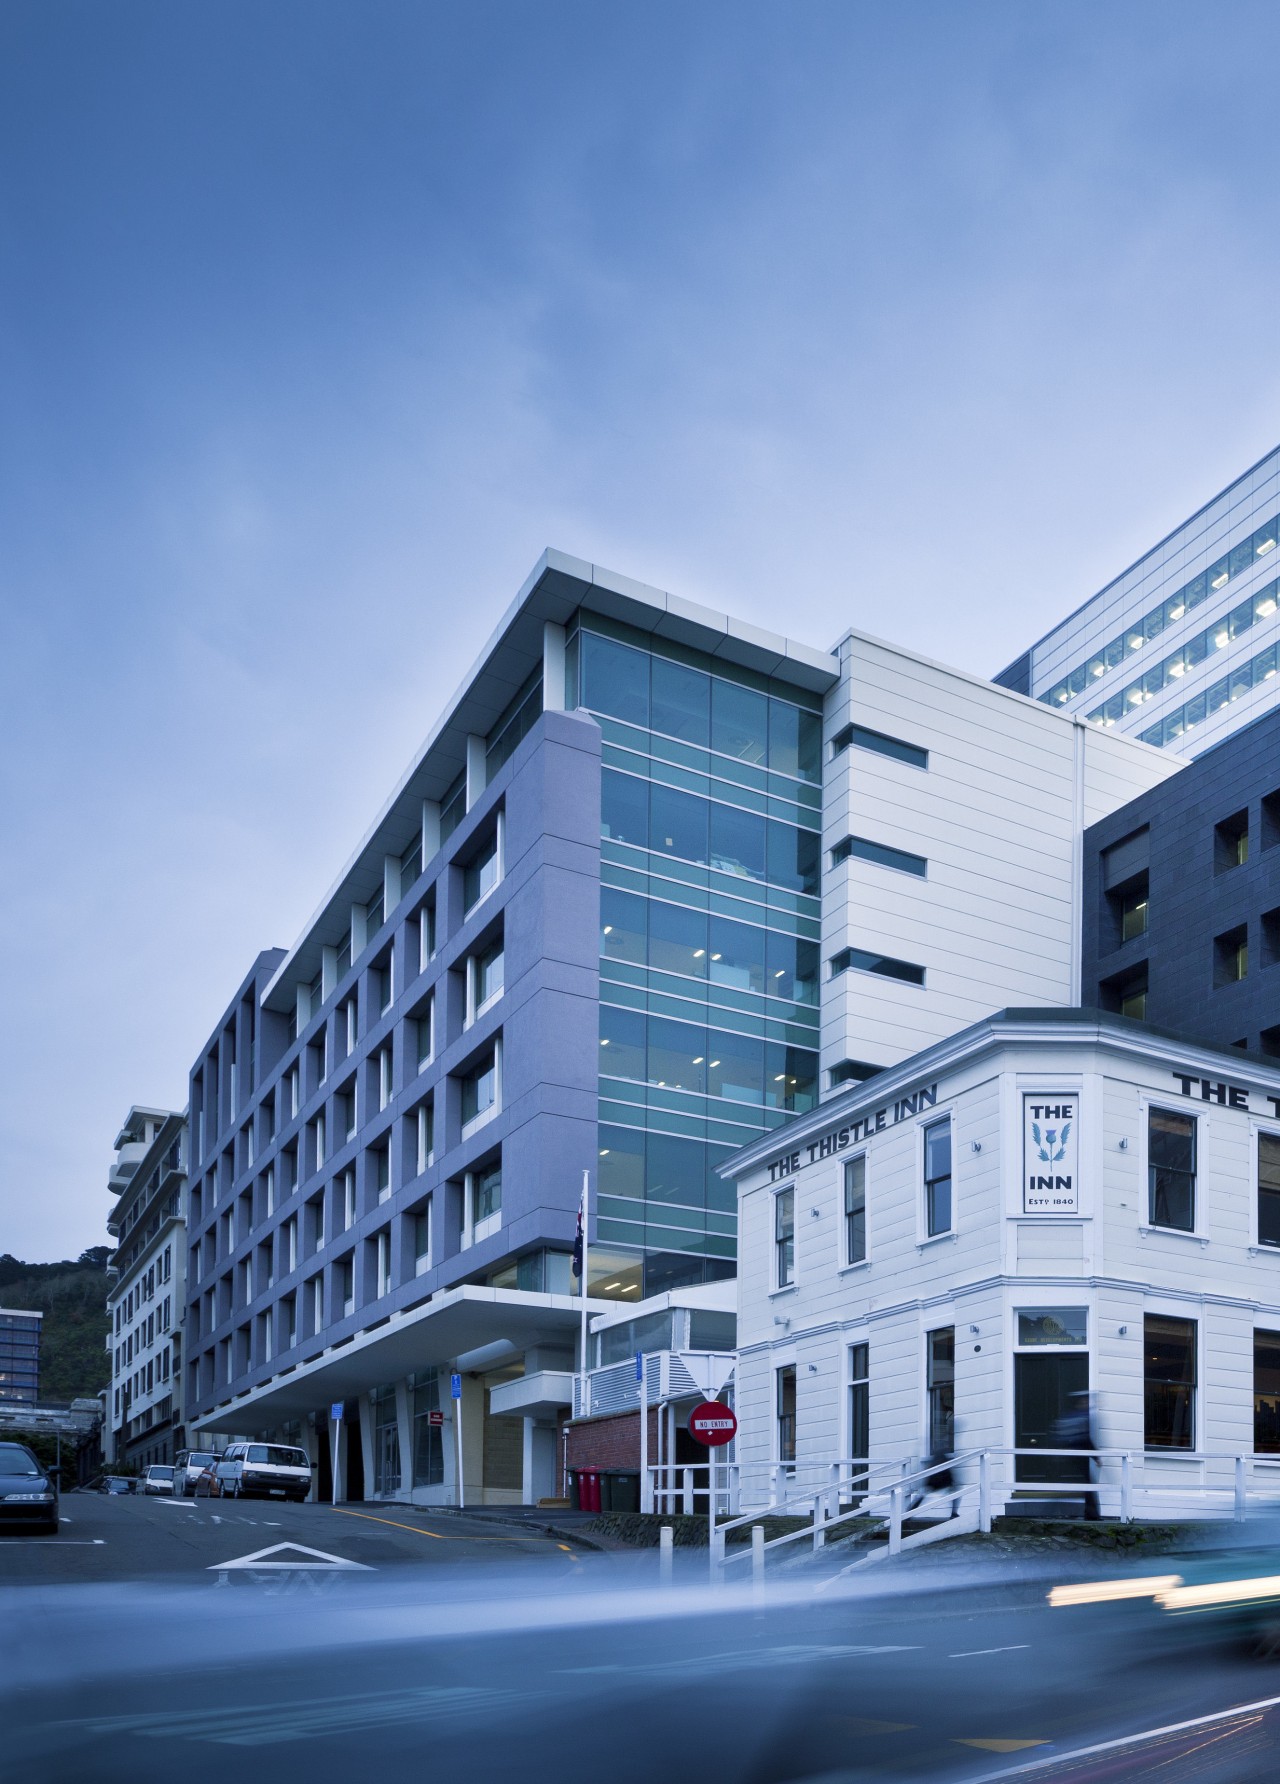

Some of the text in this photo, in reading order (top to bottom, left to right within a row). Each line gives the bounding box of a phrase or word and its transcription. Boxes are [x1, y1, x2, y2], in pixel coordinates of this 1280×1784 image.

[1173, 1072, 1249, 1110] THE
[1030, 1105, 1073, 1119] THE
[768, 1084, 937, 1181] THE THISTLE INN
[1030, 1176, 1072, 1190] INN
[711, 1420, 728, 1428] ENTRY
